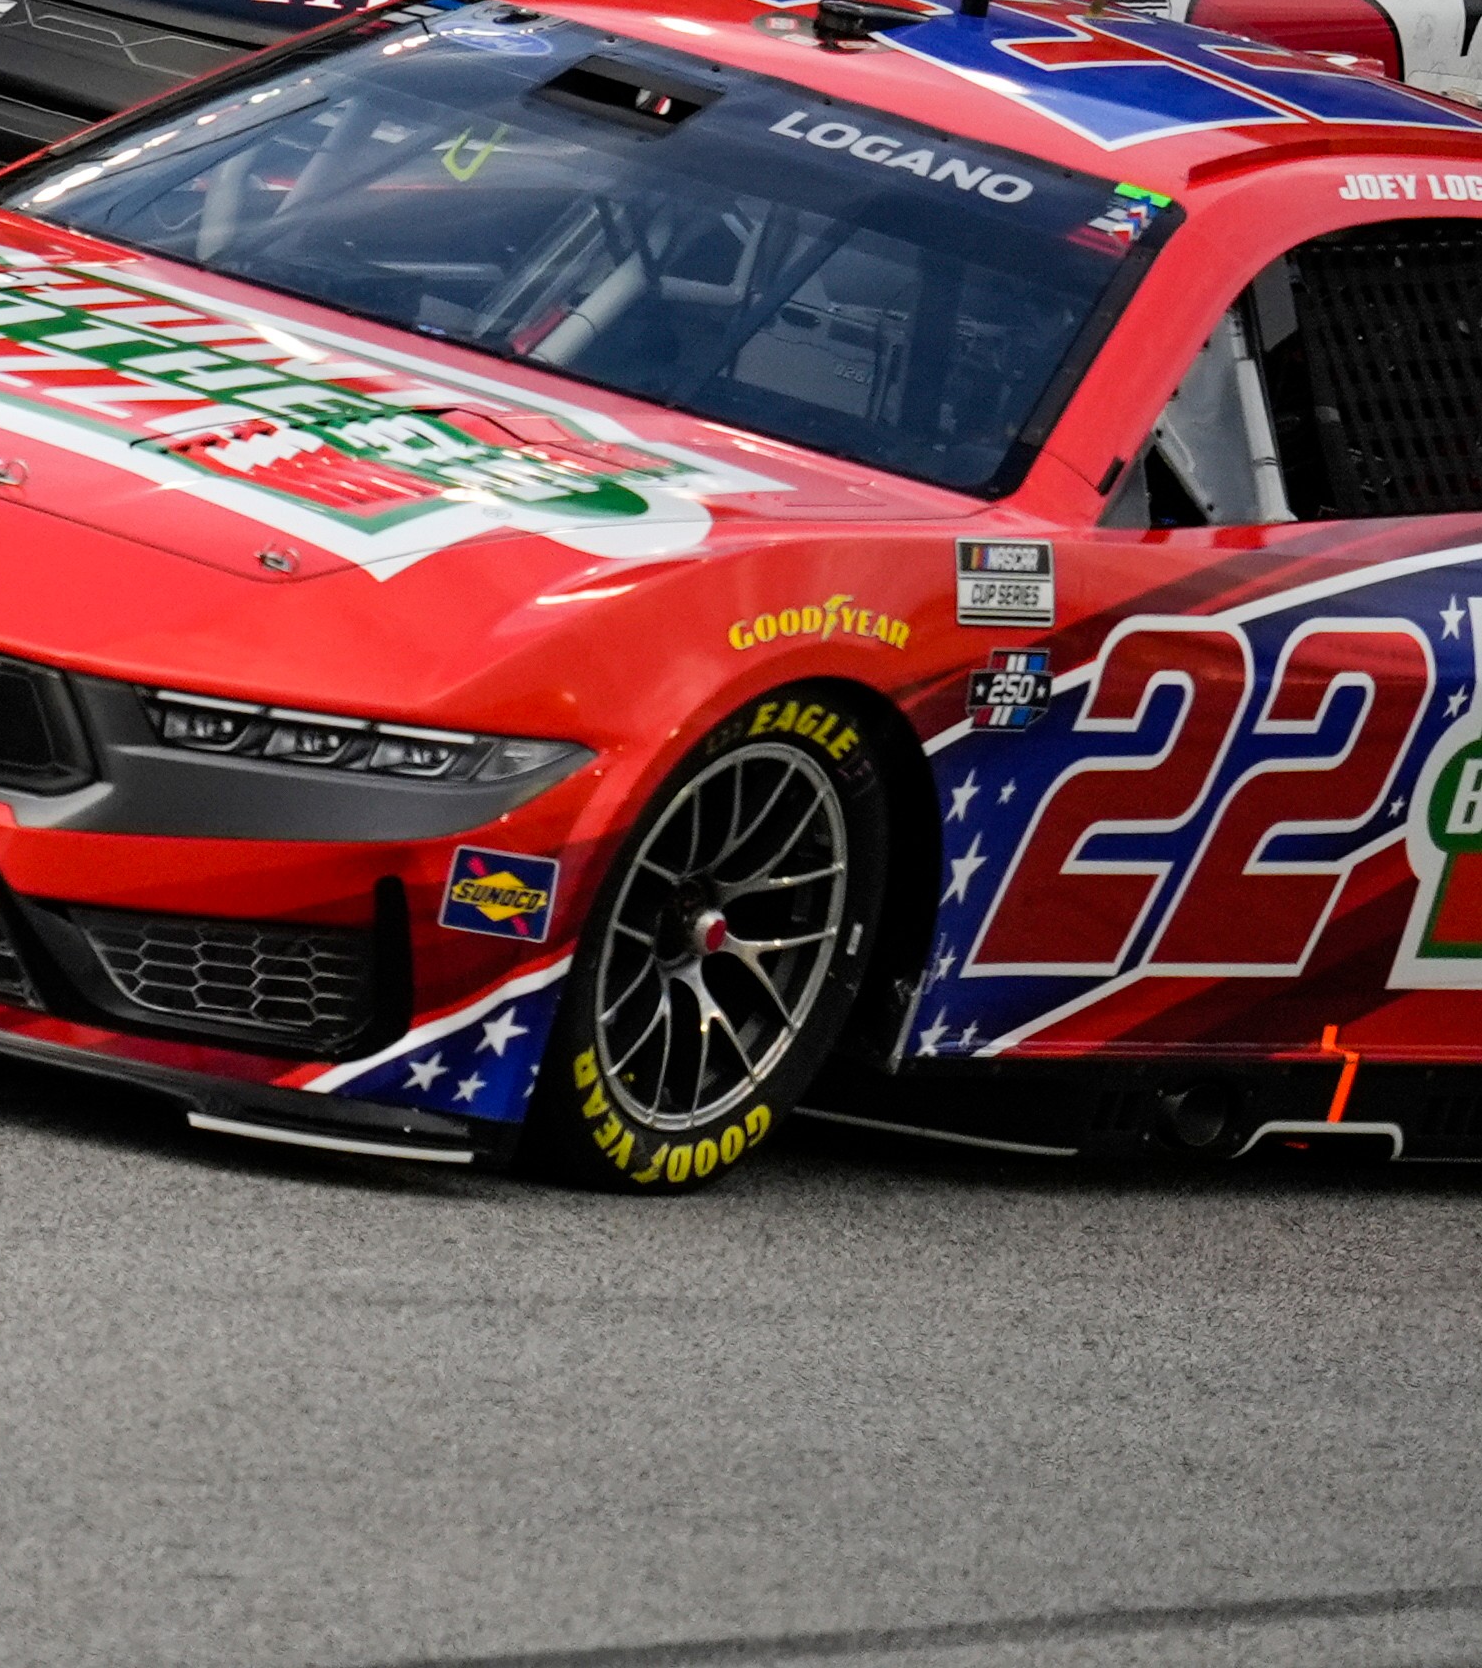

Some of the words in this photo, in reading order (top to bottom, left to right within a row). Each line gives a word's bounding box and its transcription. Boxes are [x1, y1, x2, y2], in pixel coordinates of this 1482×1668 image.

[767, 109, 1035, 205] LOGANO
[1338, 174, 1417, 201] JOEY
[971, 583, 996, 606] CUP
[997, 584, 1040, 607] SERIES
[727, 594, 912, 651] GOODYEAR
[986, 675, 1037, 705] 250
[747, 699, 859, 762] EAGLE
[958, 613, 1438, 979] 22
[455, 882, 543, 913] SUNOCO
